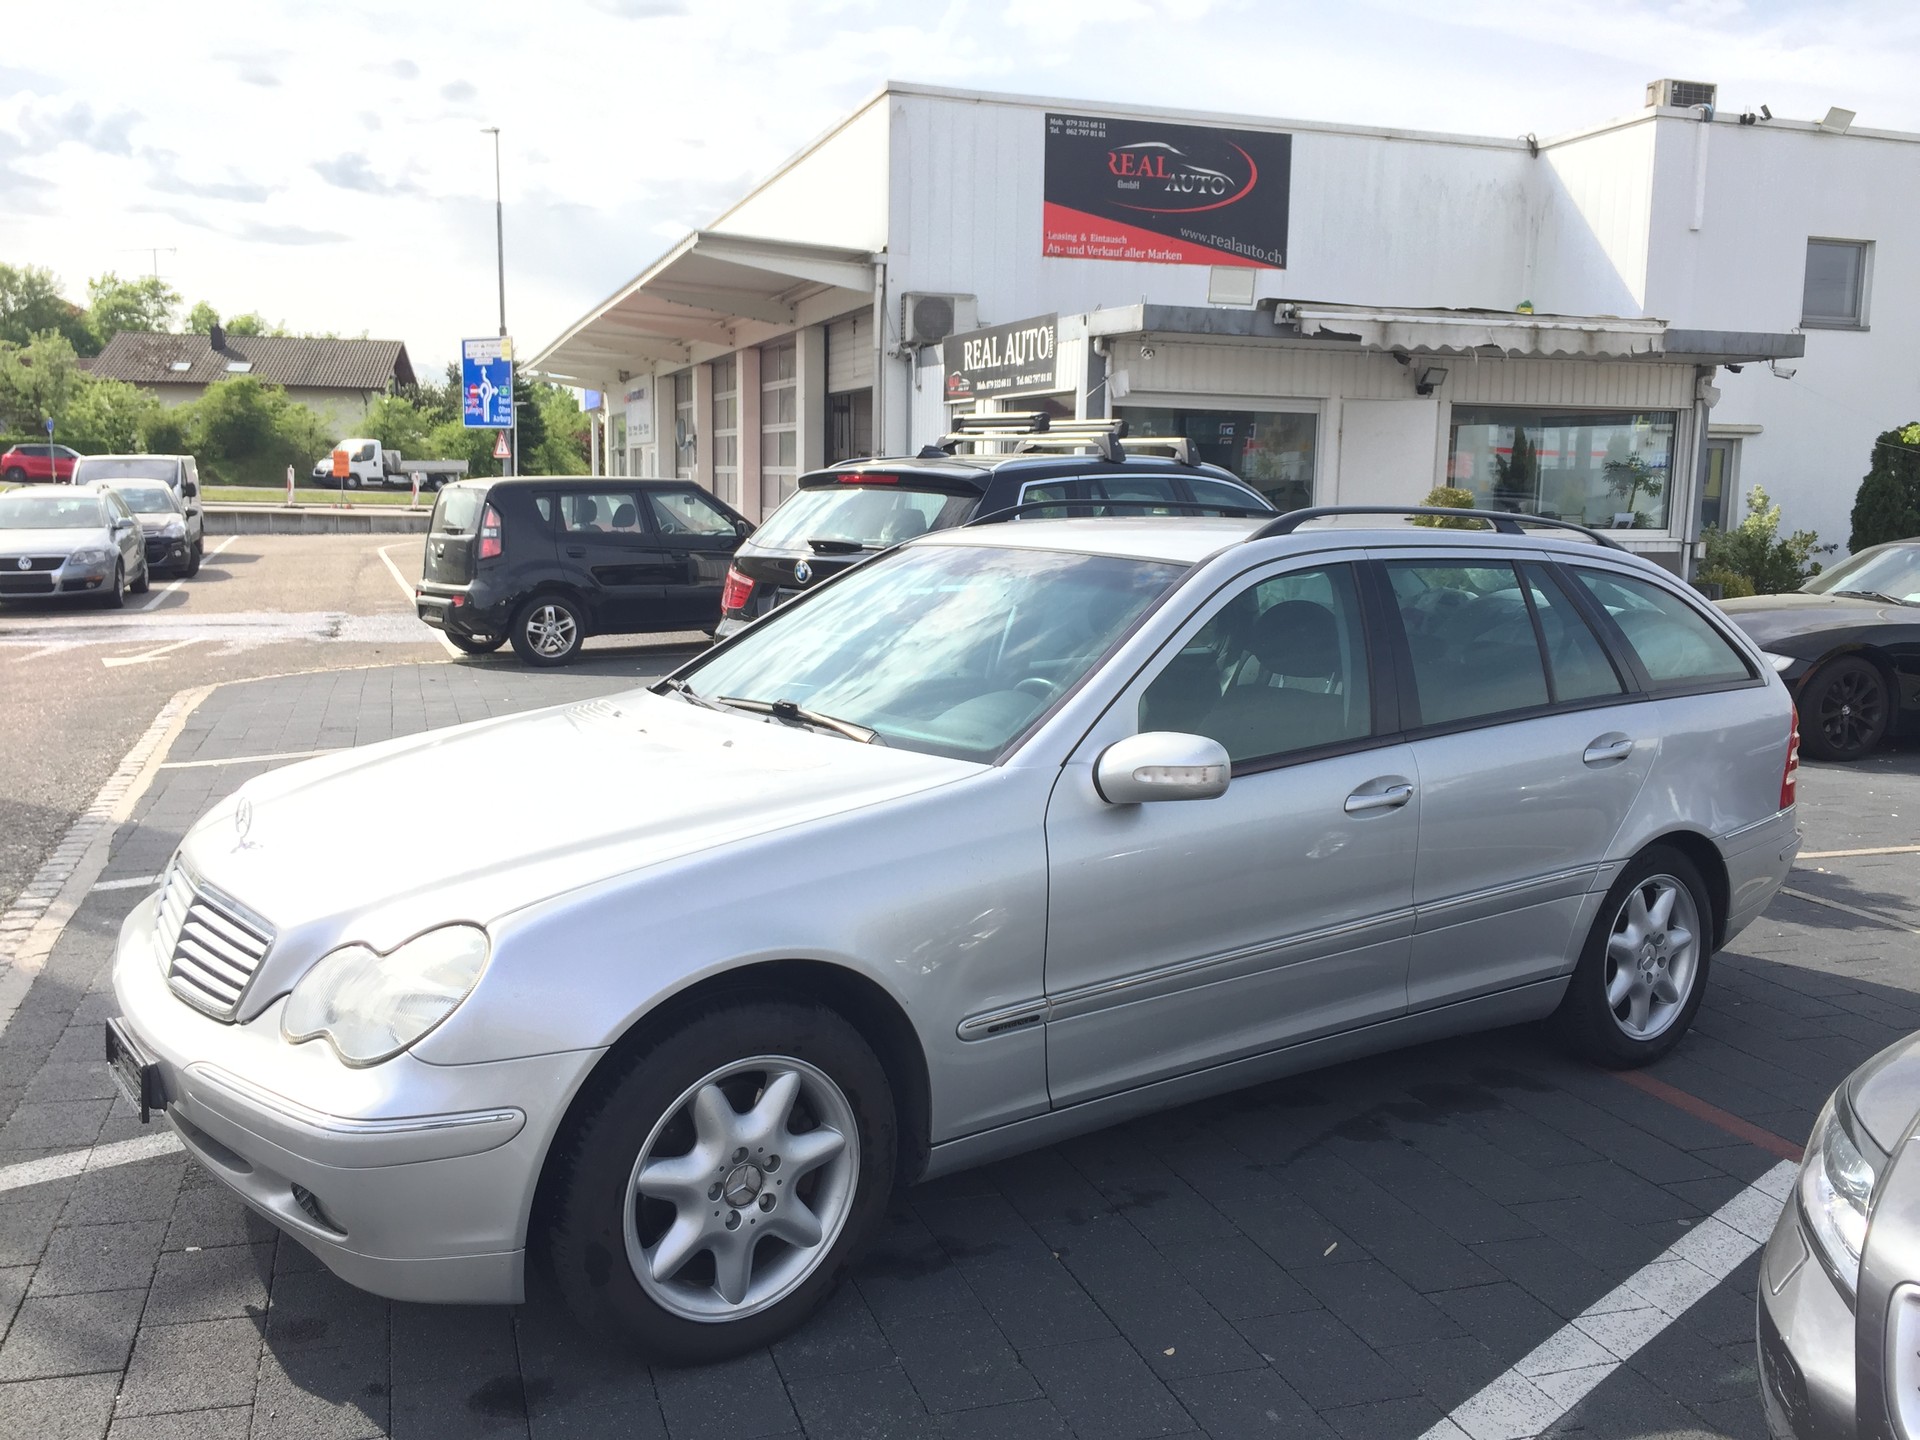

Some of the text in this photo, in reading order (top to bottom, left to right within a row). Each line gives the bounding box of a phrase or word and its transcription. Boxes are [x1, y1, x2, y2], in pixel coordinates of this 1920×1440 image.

[1050, 118, 1064, 126] Mob.
[1078, 120, 1090, 128] 332
[1050, 126, 1060, 134] Tel.
[1078, 128, 1090, 136] 797
[1108, 151, 1172, 178] REAL
[1117, 180, 1140, 190] GmbH
[1164, 173, 1226, 195] AUTO
[1048, 230, 1127, 244] Leasing & Eintausch
[1047, 243, 1182, 260] An- und Verkauf aller Marken
[1180, 227, 1282, 265] www.realauto.ch
[964, 326, 1049, 372] REAL AUTO
